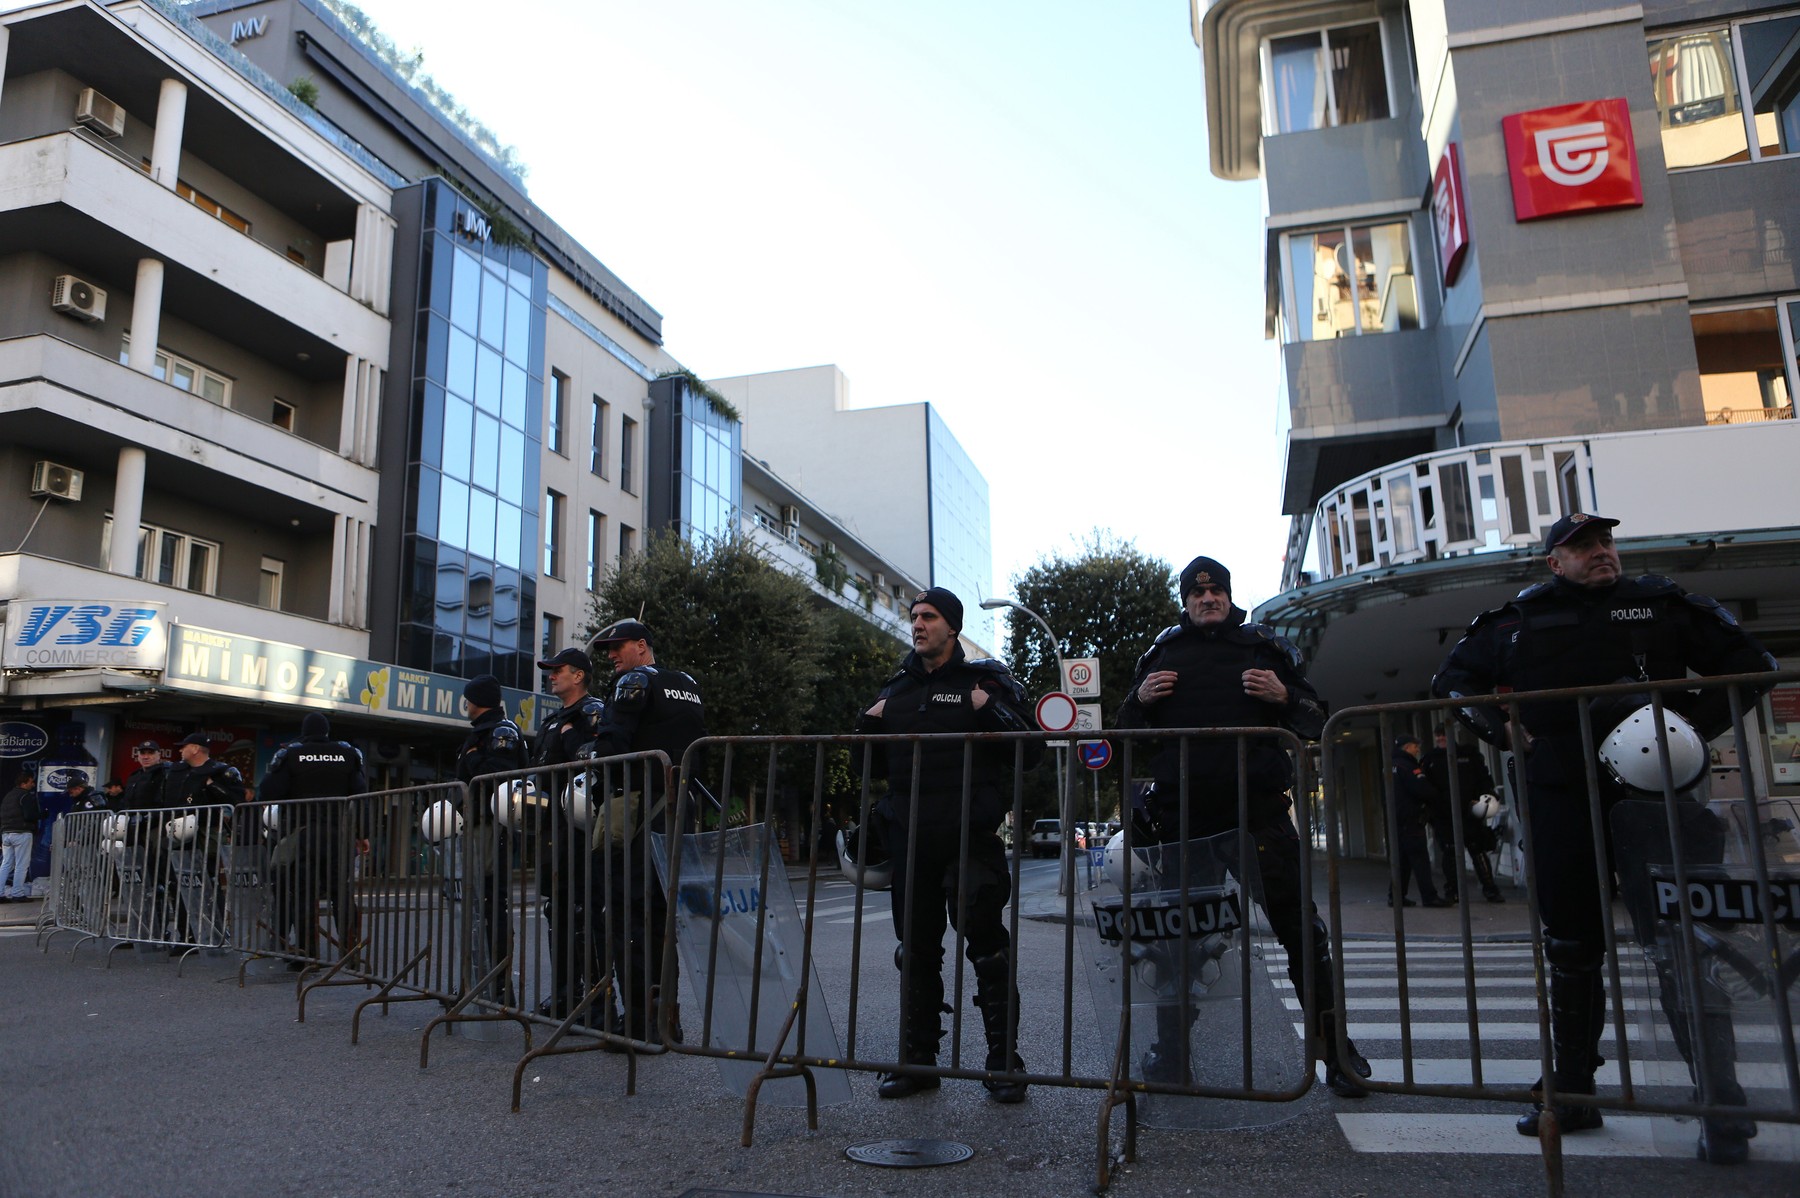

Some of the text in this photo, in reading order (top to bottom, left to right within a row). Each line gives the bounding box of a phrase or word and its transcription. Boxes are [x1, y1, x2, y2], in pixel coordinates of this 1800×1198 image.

[1610, 607, 1653, 621] POLICIJA
[15, 605, 158, 647] VSG
[183, 629, 232, 649] MARKET
[26, 649, 138, 664] COMMERCE
[180, 643, 351, 699] MIMOZA
[398, 671, 430, 685] MARKET
[1073, 668, 1087, 680] 30
[664, 688, 702, 705] POLICIJA
[1072, 686, 1090, 694] ZONA
[932, 693, 962, 703] POLICIJA
[299, 754, 346, 763] POLICIJA
[1095, 852, 1102, 862] P
[1096, 900, 1240, 937] POLICIJA
